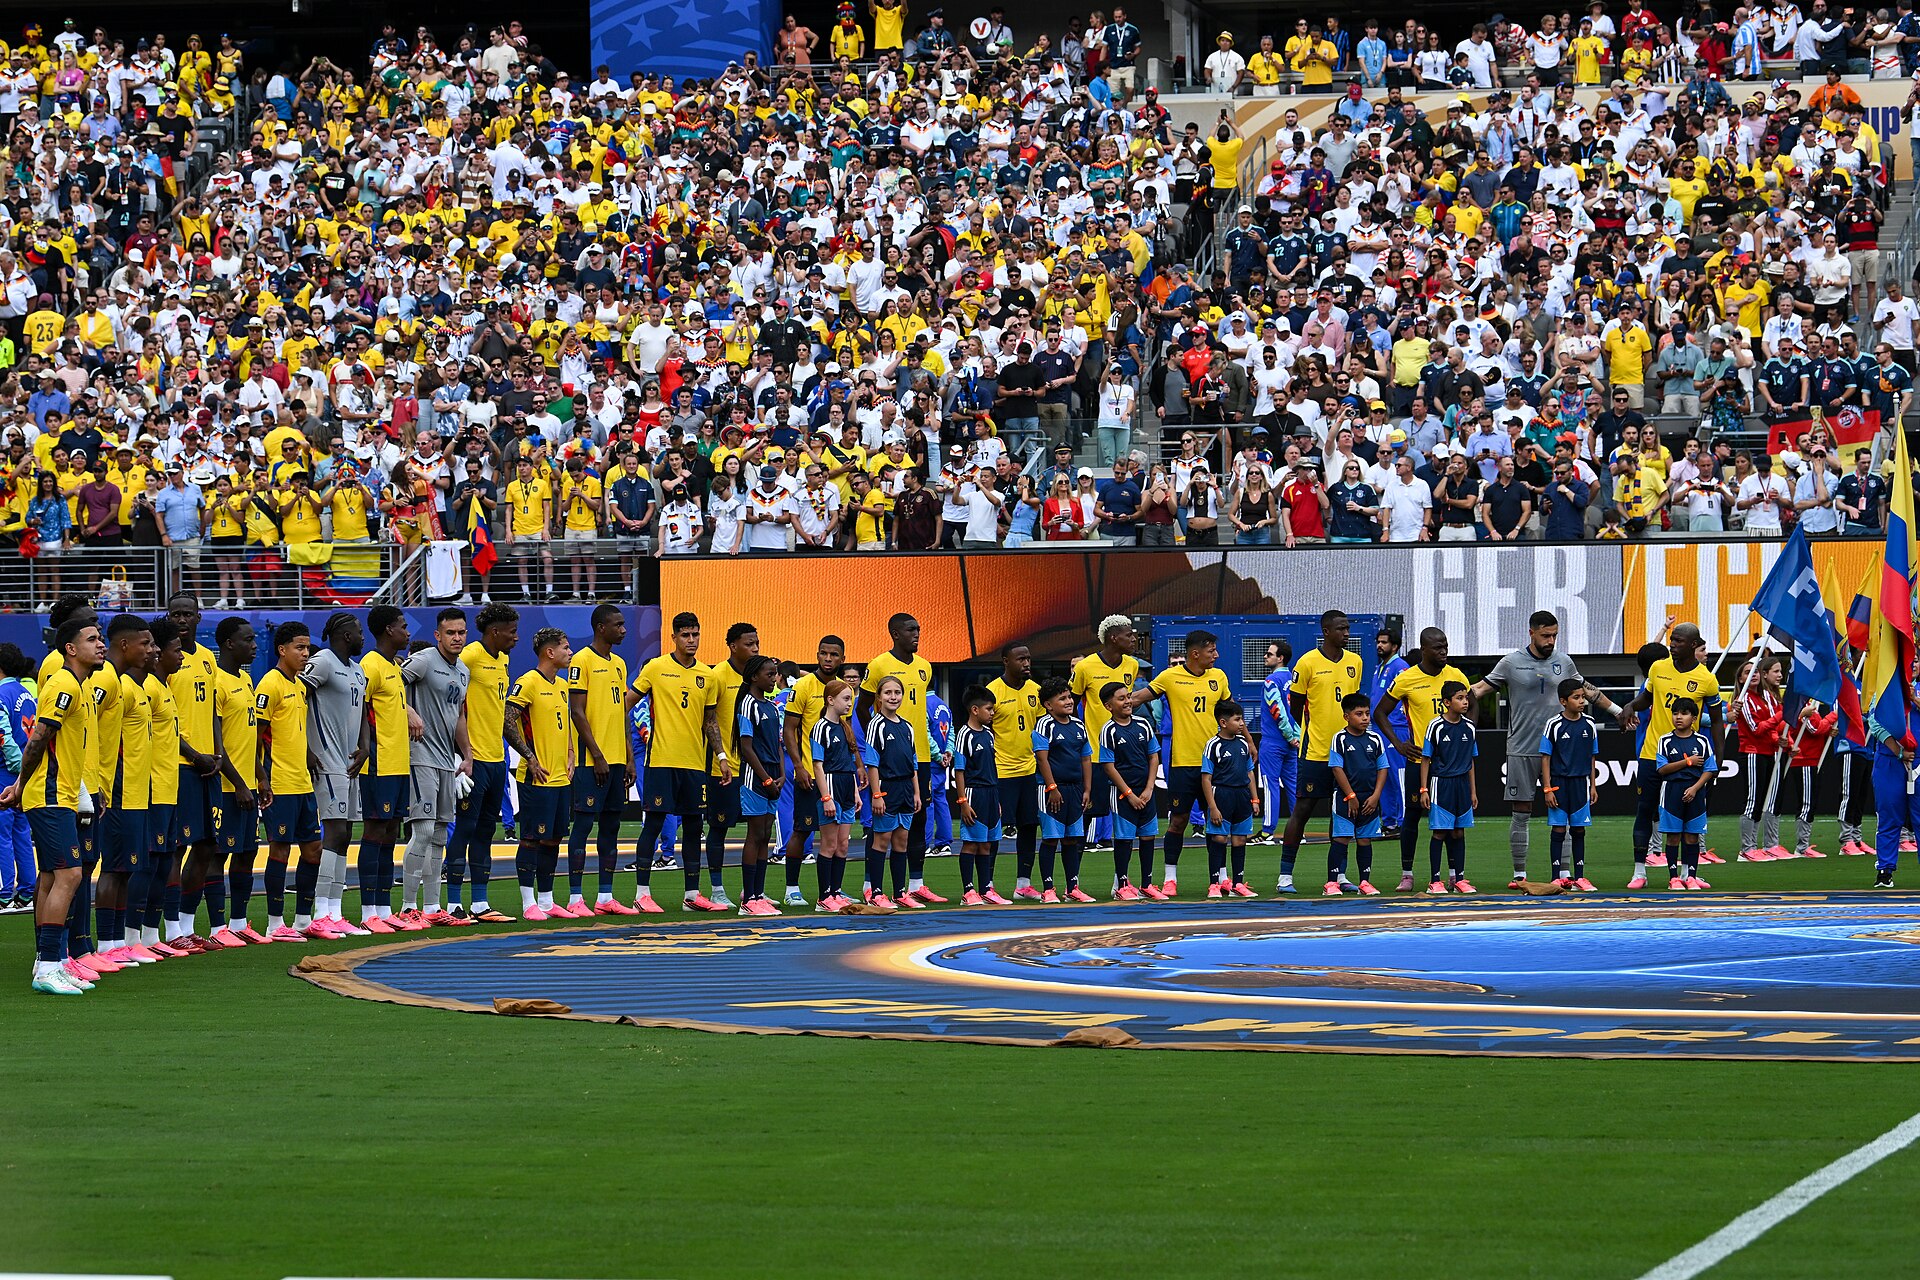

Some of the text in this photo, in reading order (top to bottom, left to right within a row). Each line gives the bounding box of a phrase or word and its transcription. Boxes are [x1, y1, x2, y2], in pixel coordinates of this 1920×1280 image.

[1863, 105, 1901, 142] up
[704, 162, 711, 172] 6
[1274, 246, 1285, 257] 22
[1315, 243, 1325, 254] 18
[36, 322, 54, 342] 23
[1771, 374, 1783, 386] 14
[980, 451, 989, 460] 17
[1413, 546, 1588, 656] GER
[350, 687, 359, 707] 12
[447, 685, 460, 704] 22
[498, 682, 504, 700] 11
[611, 686, 620, 704] 18
[681, 691, 689, 709] 3
[909, 688, 917, 705] 4
[1335, 686, 1342, 702] 6
[1193, 696, 1206, 713] 21
[1431, 698, 1444, 715] 13
[556, 711, 563, 730] 5
[1018, 715, 1026, 731] 9
[725, 998, 1148, 1027] FIFA
[1166, 1017, 1920, 1044] WORL
